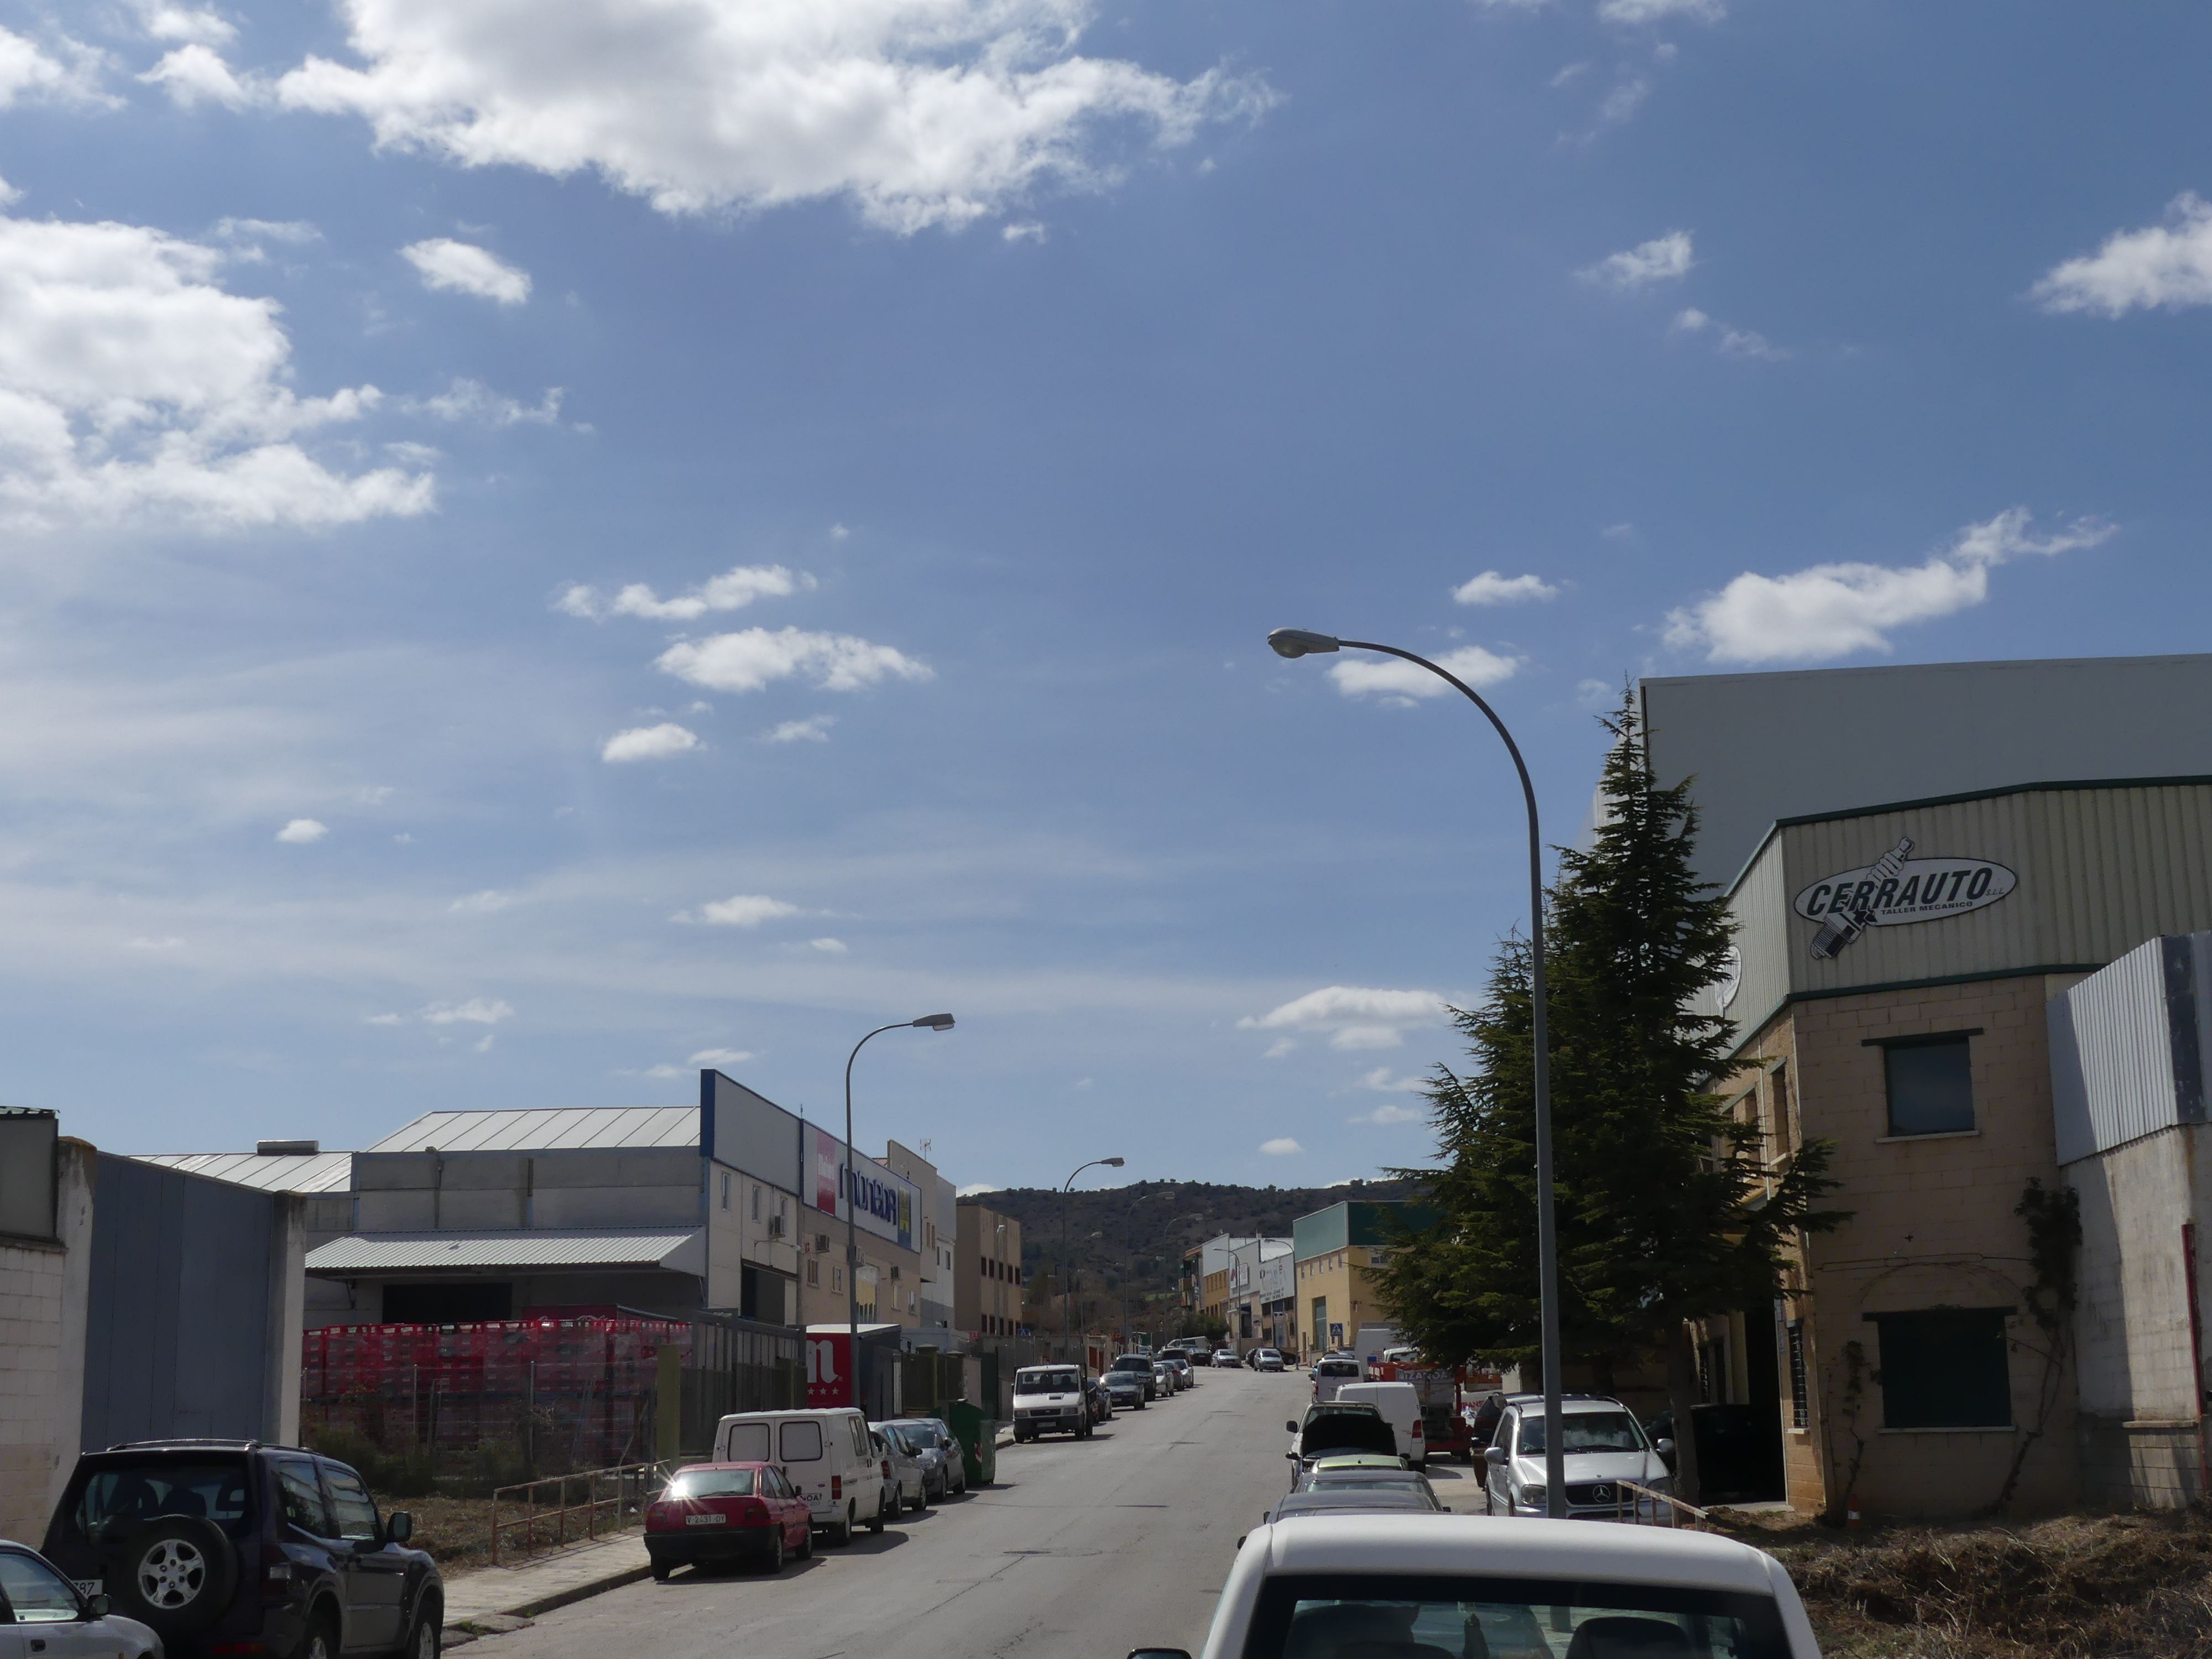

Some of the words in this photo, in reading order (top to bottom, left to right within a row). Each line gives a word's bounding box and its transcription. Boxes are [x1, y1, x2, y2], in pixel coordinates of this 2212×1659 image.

[1807, 868, 1992, 916] CERRAUTO
[1881, 906, 1916, 915] TALLER
[1919, 901, 1973, 911] MECANICO
